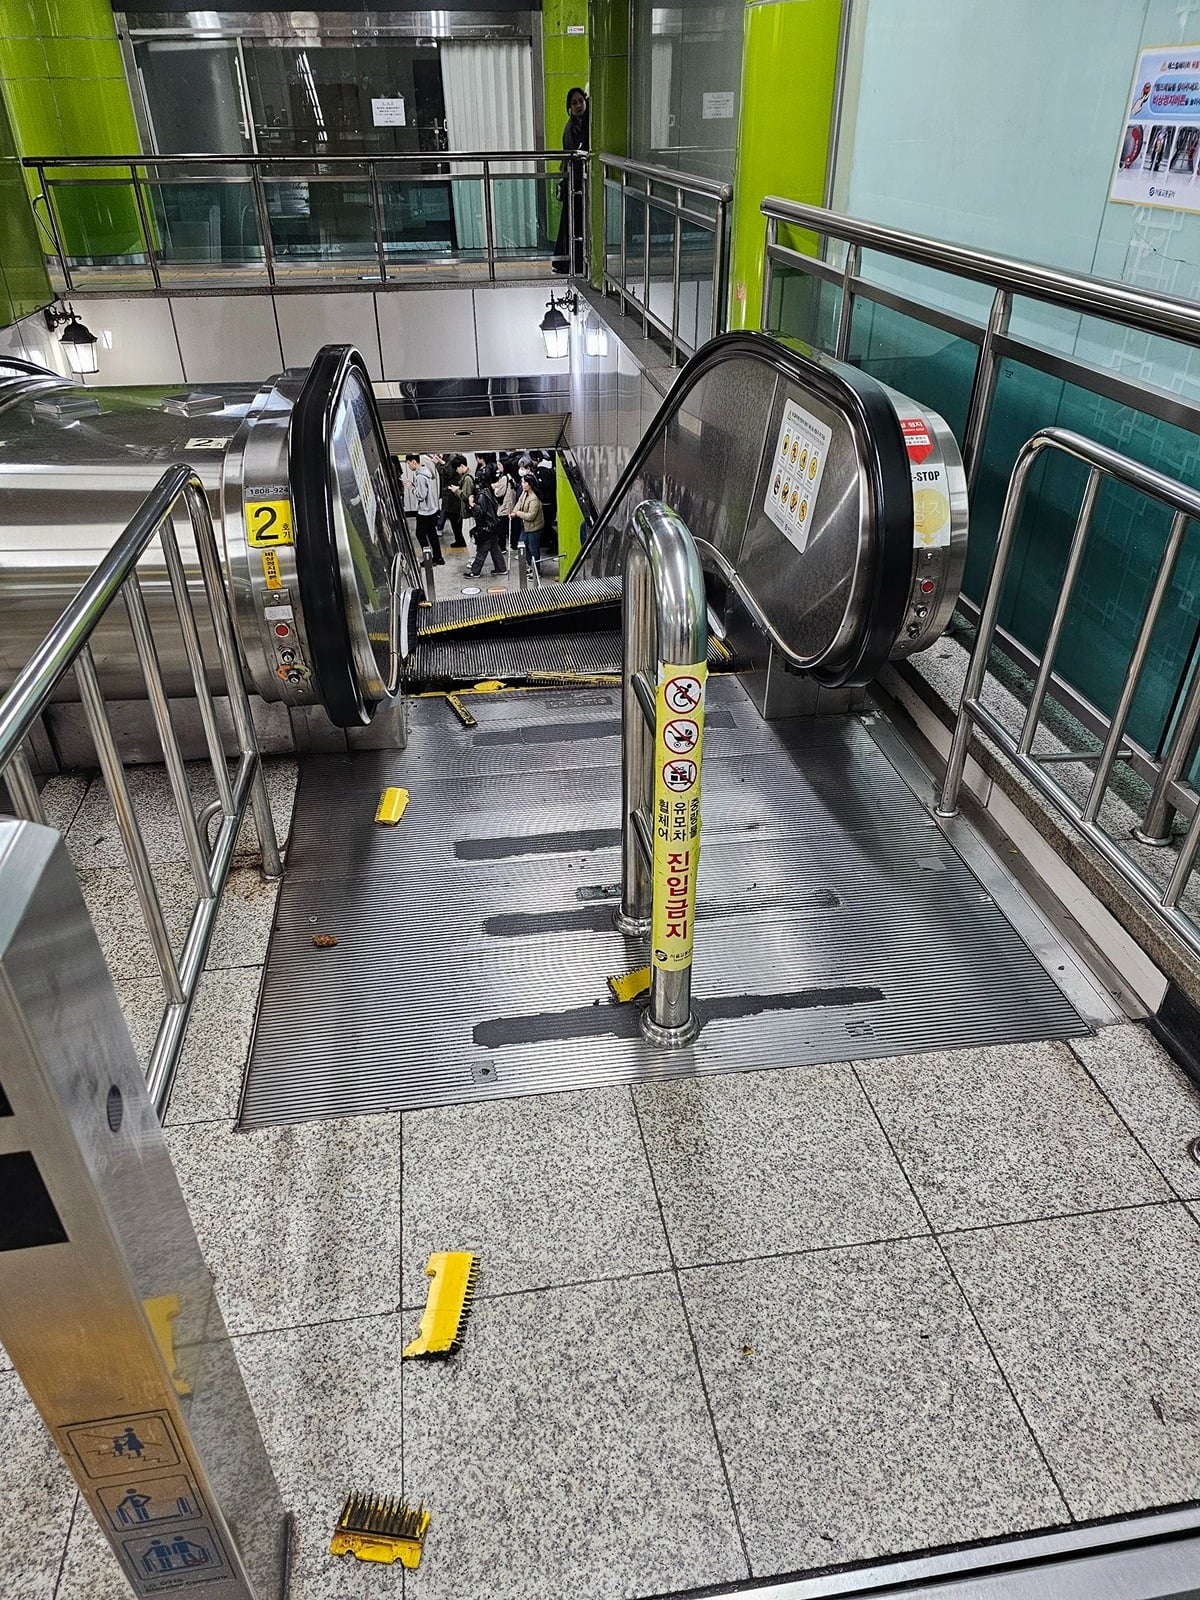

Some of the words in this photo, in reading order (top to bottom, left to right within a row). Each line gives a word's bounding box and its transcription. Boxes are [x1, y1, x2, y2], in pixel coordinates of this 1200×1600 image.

[192, 439, 214, 447] 2
[254, 506, 279, 541] 2
[658, 798, 669, 842] 휠체어
[673, 802, 687, 842] 유모차
[665, 851, 690, 940] 진입금지
